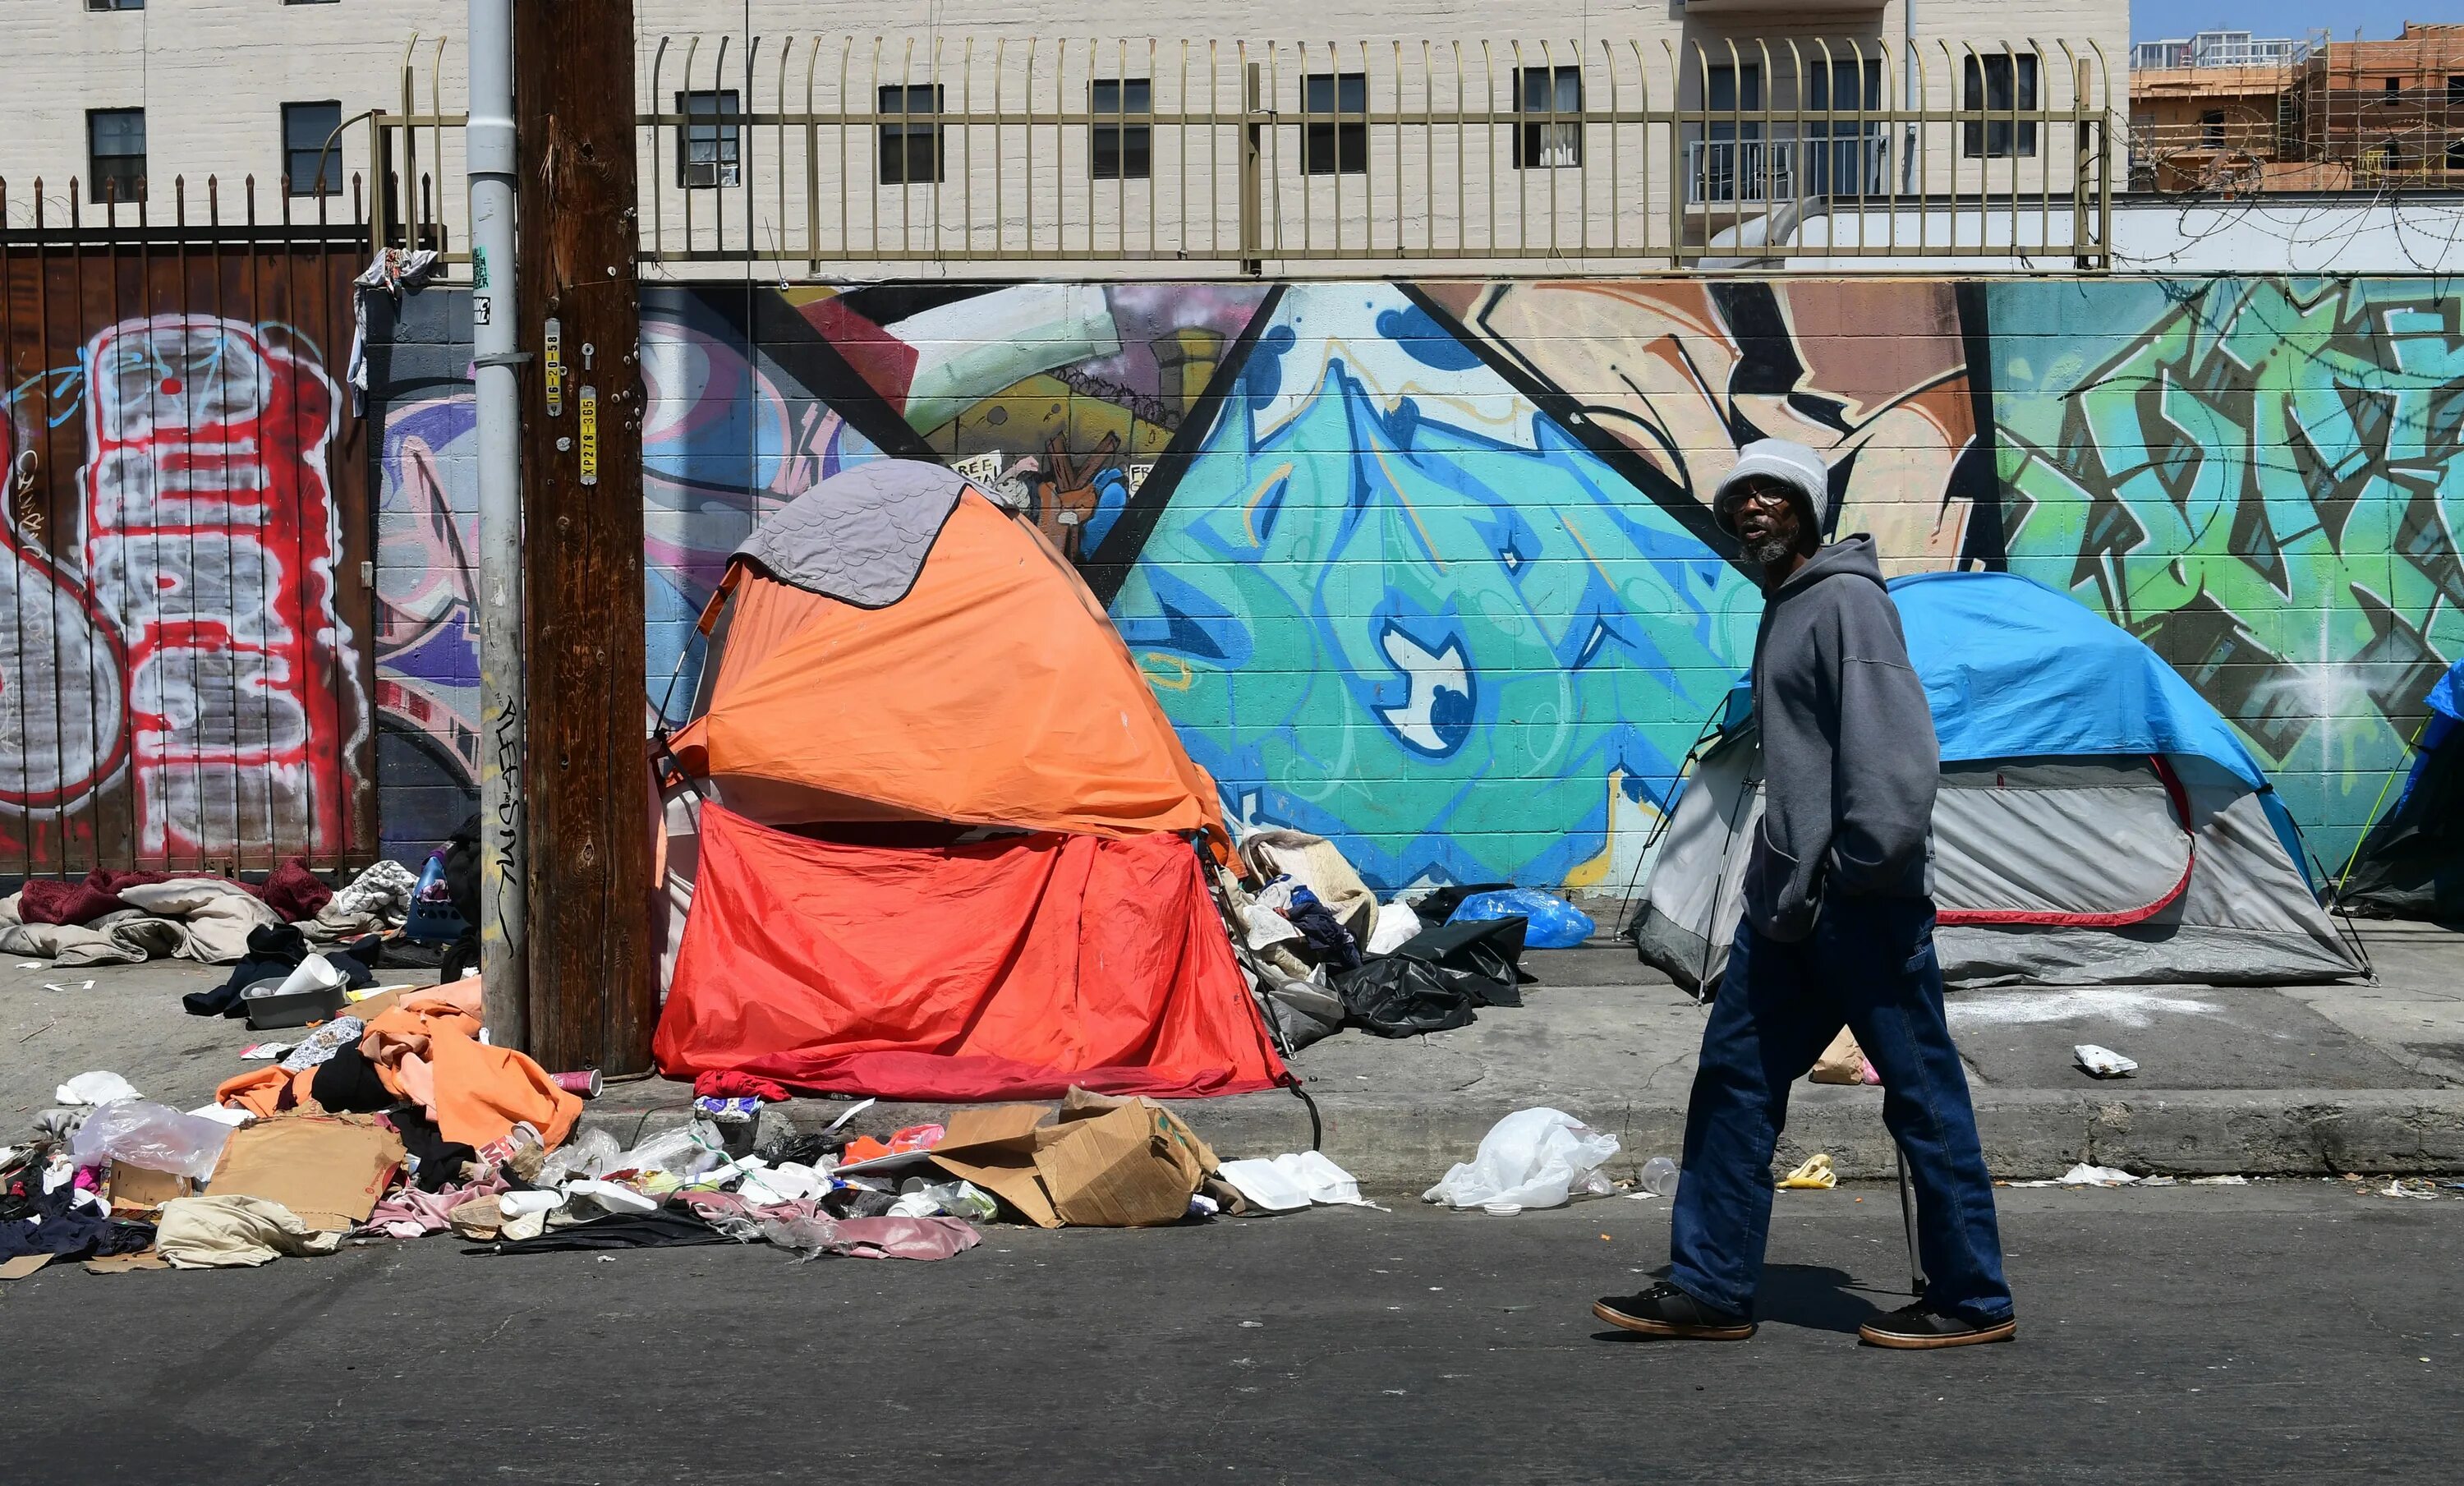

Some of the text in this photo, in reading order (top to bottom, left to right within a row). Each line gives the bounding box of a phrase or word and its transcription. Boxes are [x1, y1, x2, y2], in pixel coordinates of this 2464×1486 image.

[547, 335, 559, 404] 16-20-58
[582, 399, 595, 476] XP278-365
[958, 458, 992, 476] REE
[1131, 466, 1150, 481] FR
